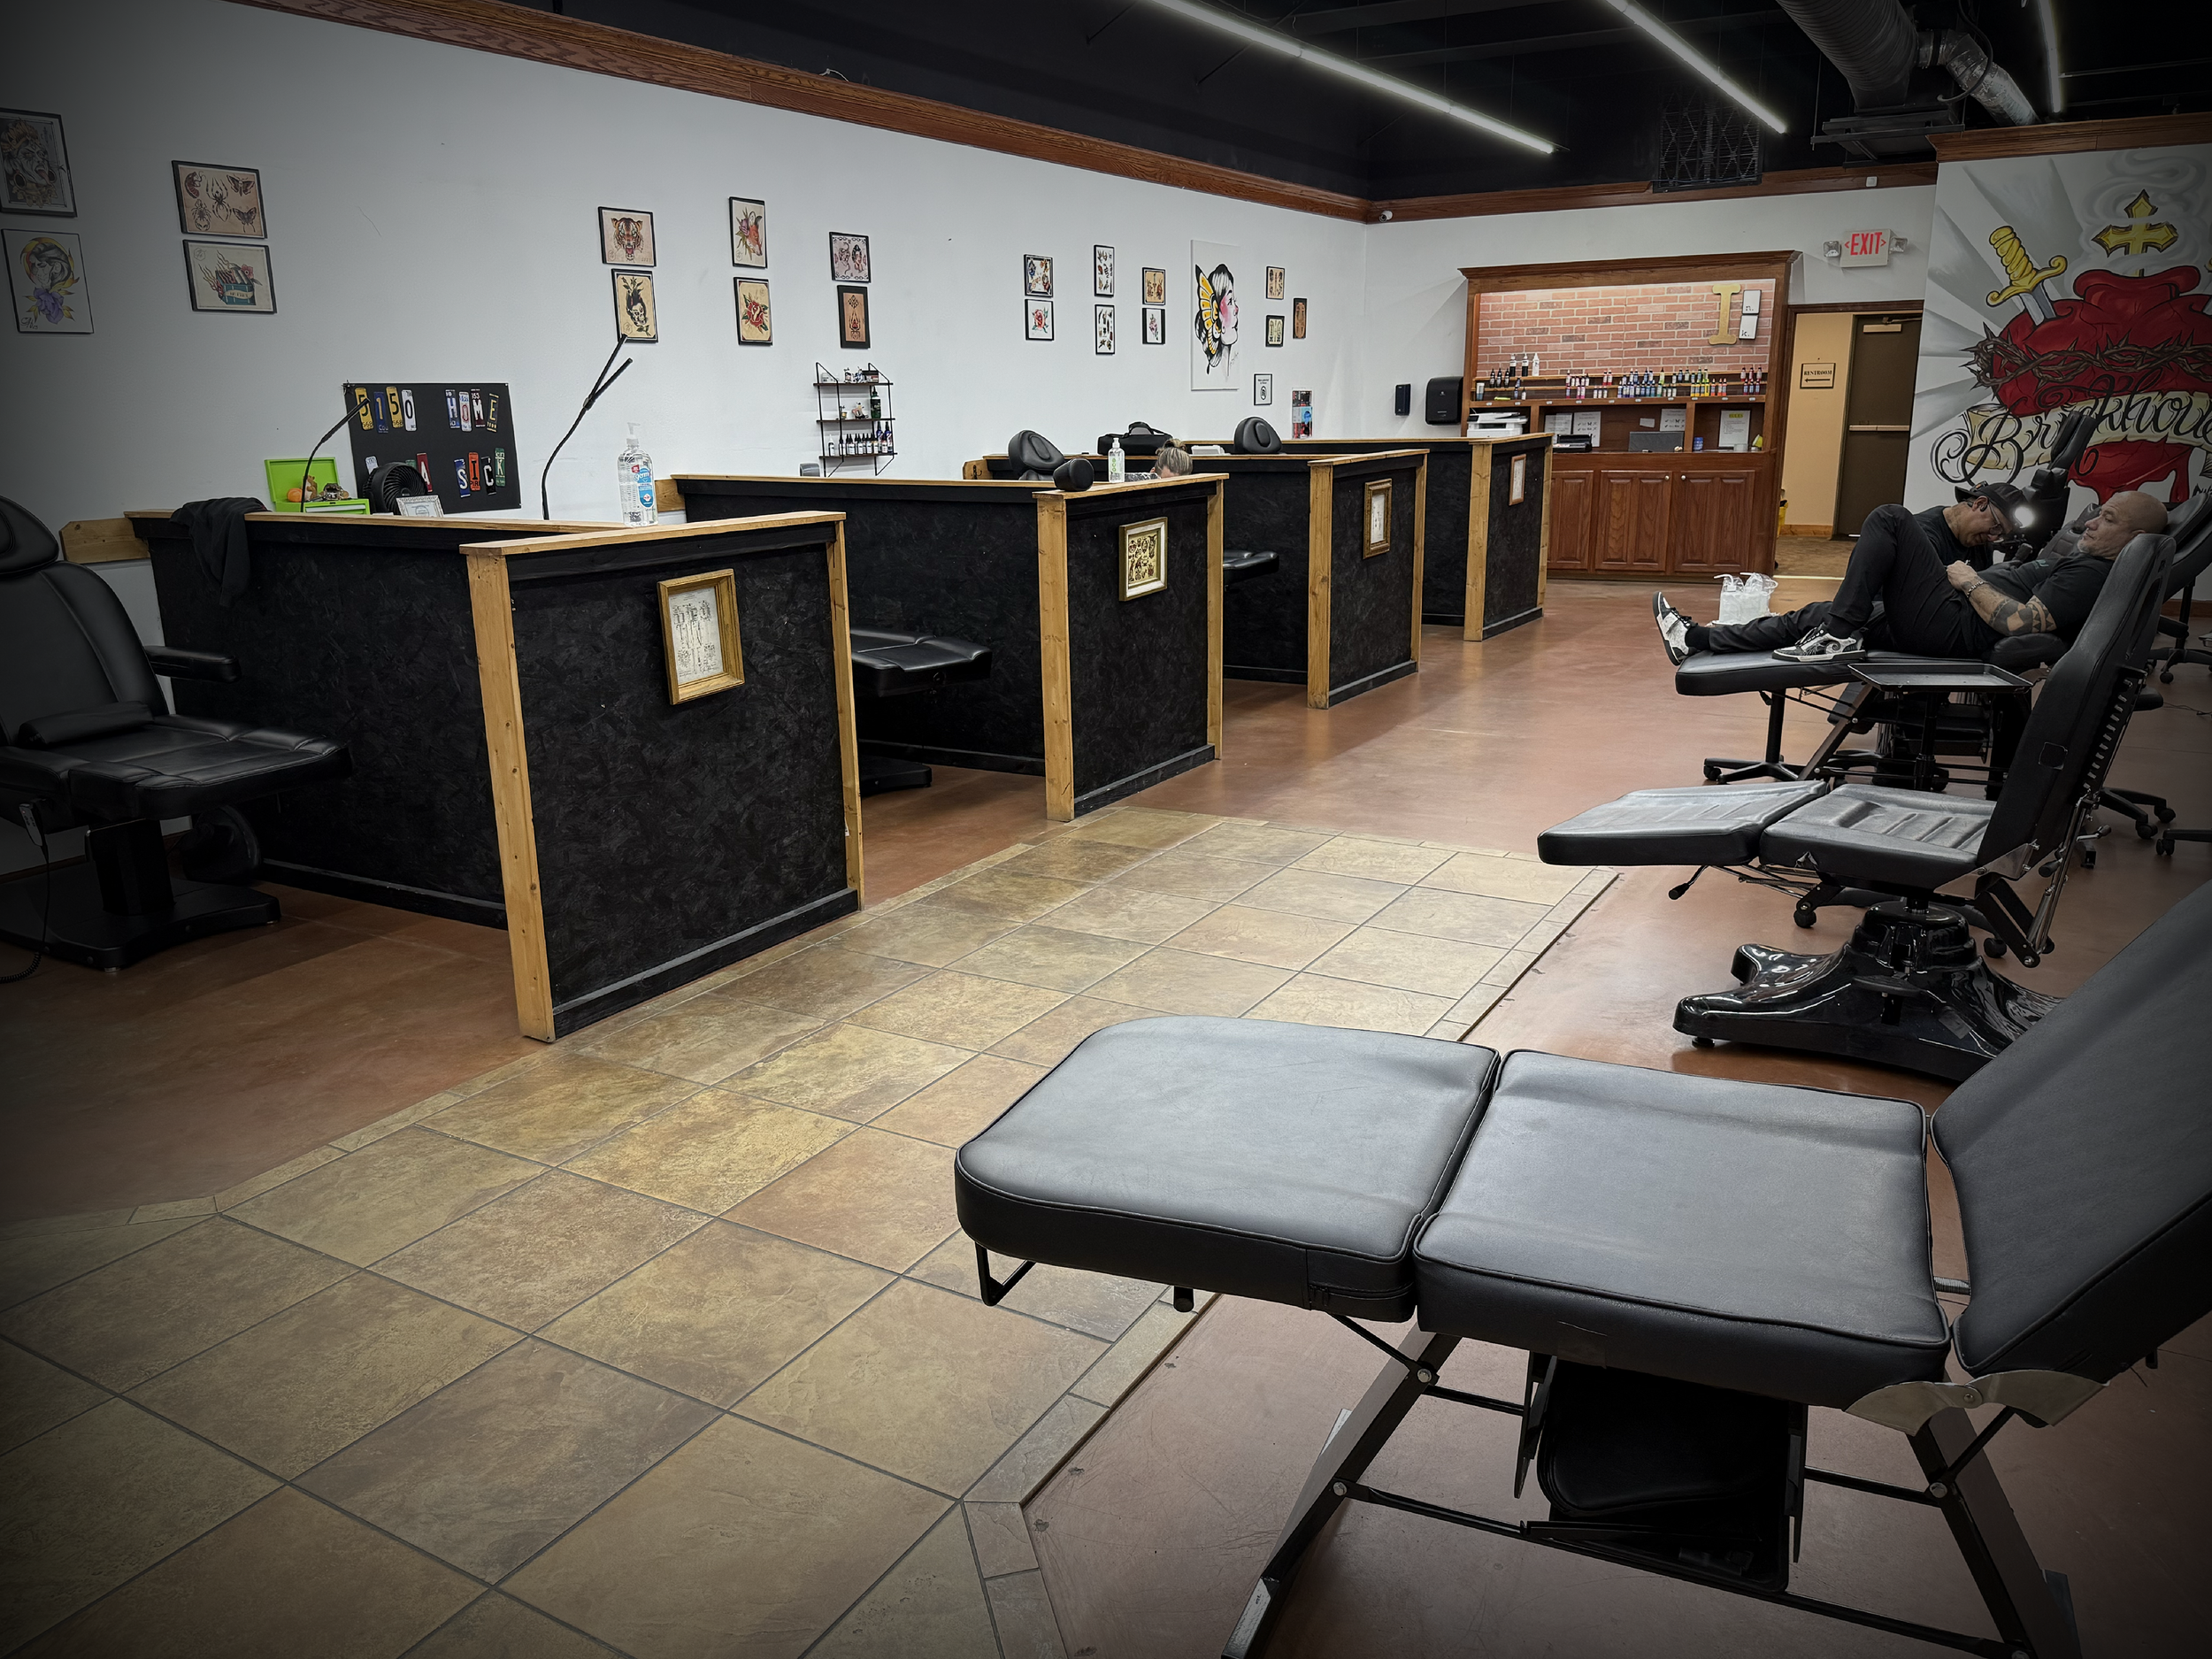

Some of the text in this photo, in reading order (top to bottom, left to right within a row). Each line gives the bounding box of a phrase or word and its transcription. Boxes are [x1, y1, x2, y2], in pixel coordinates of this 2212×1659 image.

[1850, 231, 1883, 256] EXIT
[447, 397, 497, 421] HOME
[457, 458, 505, 490] SICK
